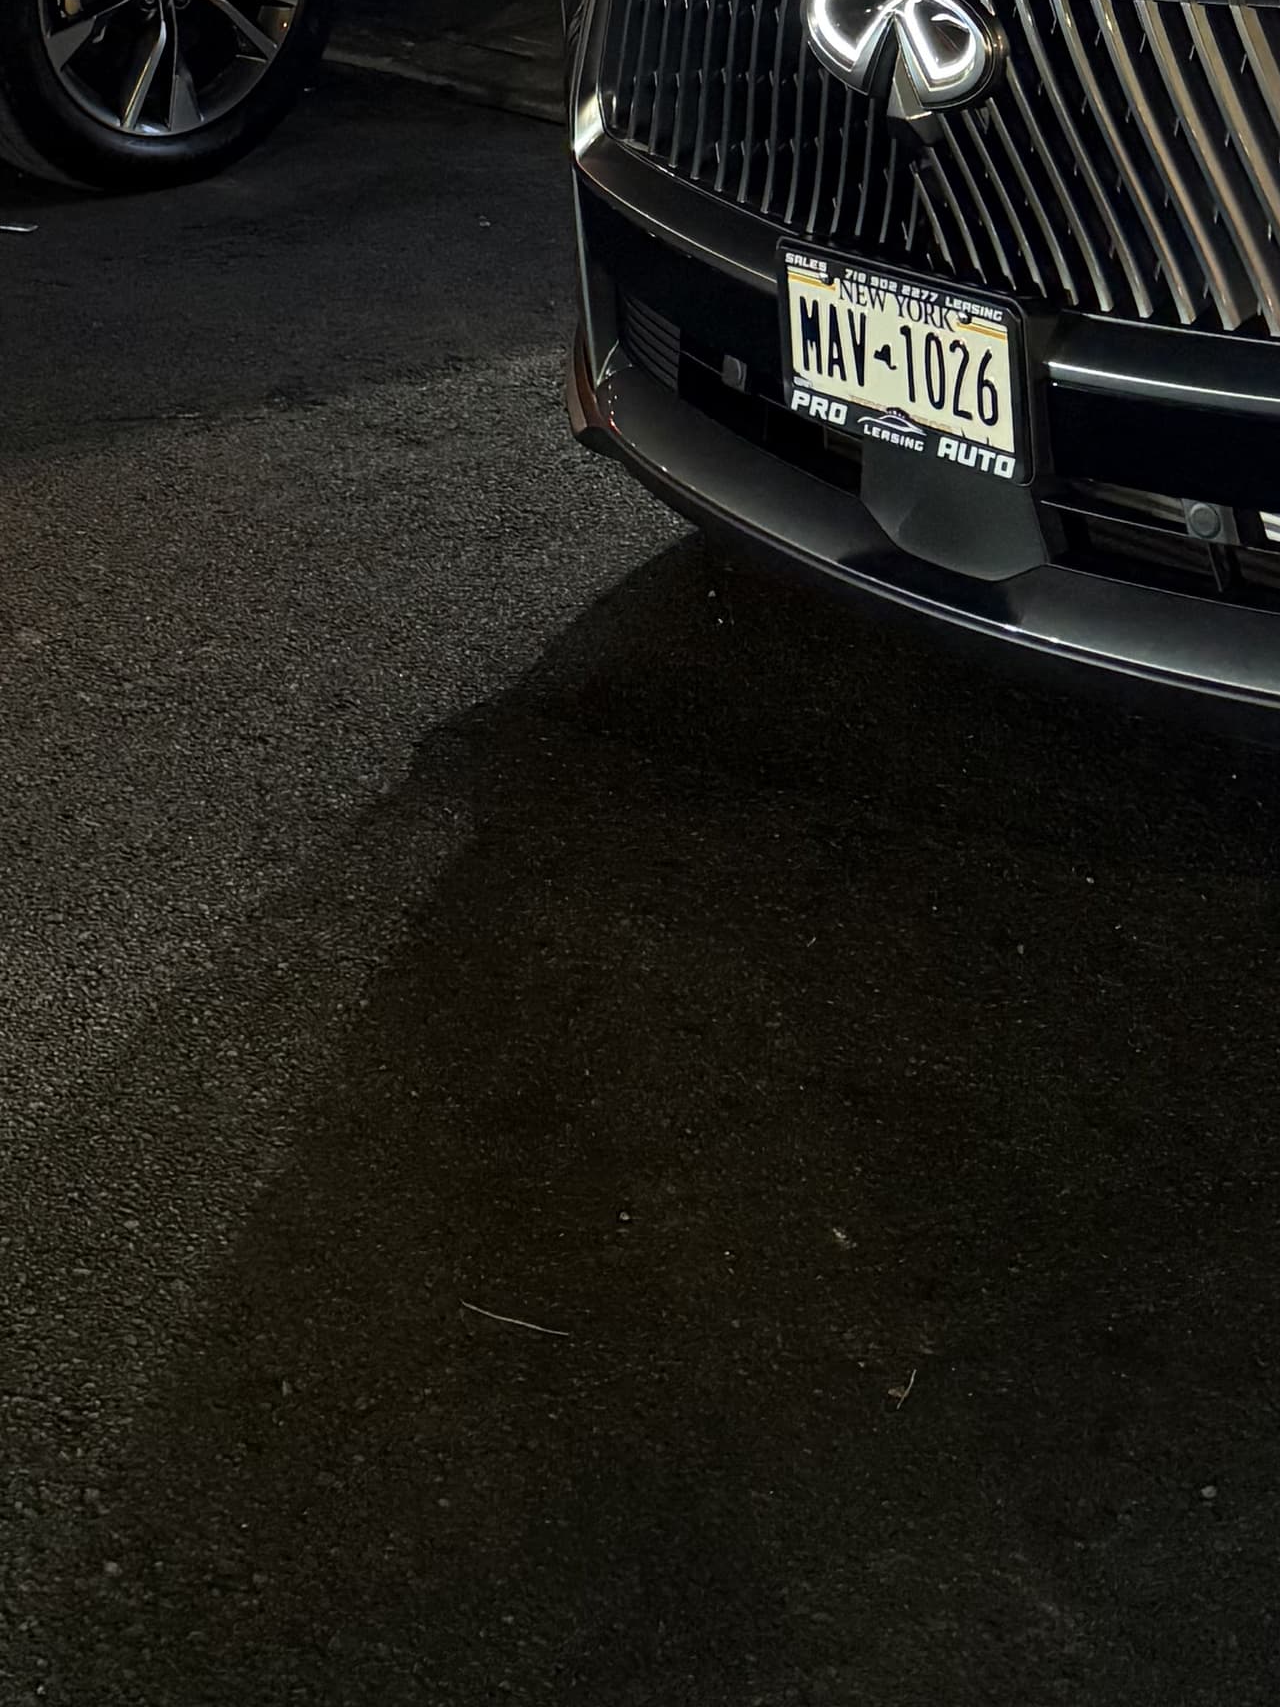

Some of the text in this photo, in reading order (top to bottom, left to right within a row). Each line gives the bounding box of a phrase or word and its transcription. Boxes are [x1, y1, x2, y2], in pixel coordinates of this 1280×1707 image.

[785, 252, 828, 273] SALES
[900, 283, 940, 303] 2277
[944, 296, 1004, 323] LEASING
[835, 277, 956, 333] NEW YORK
[799, 295, 999, 428] MAV 1026
[790, 389, 849, 426] PRO
[863, 423, 925, 453] LEASING
[936, 436, 1017, 479] AUTO
